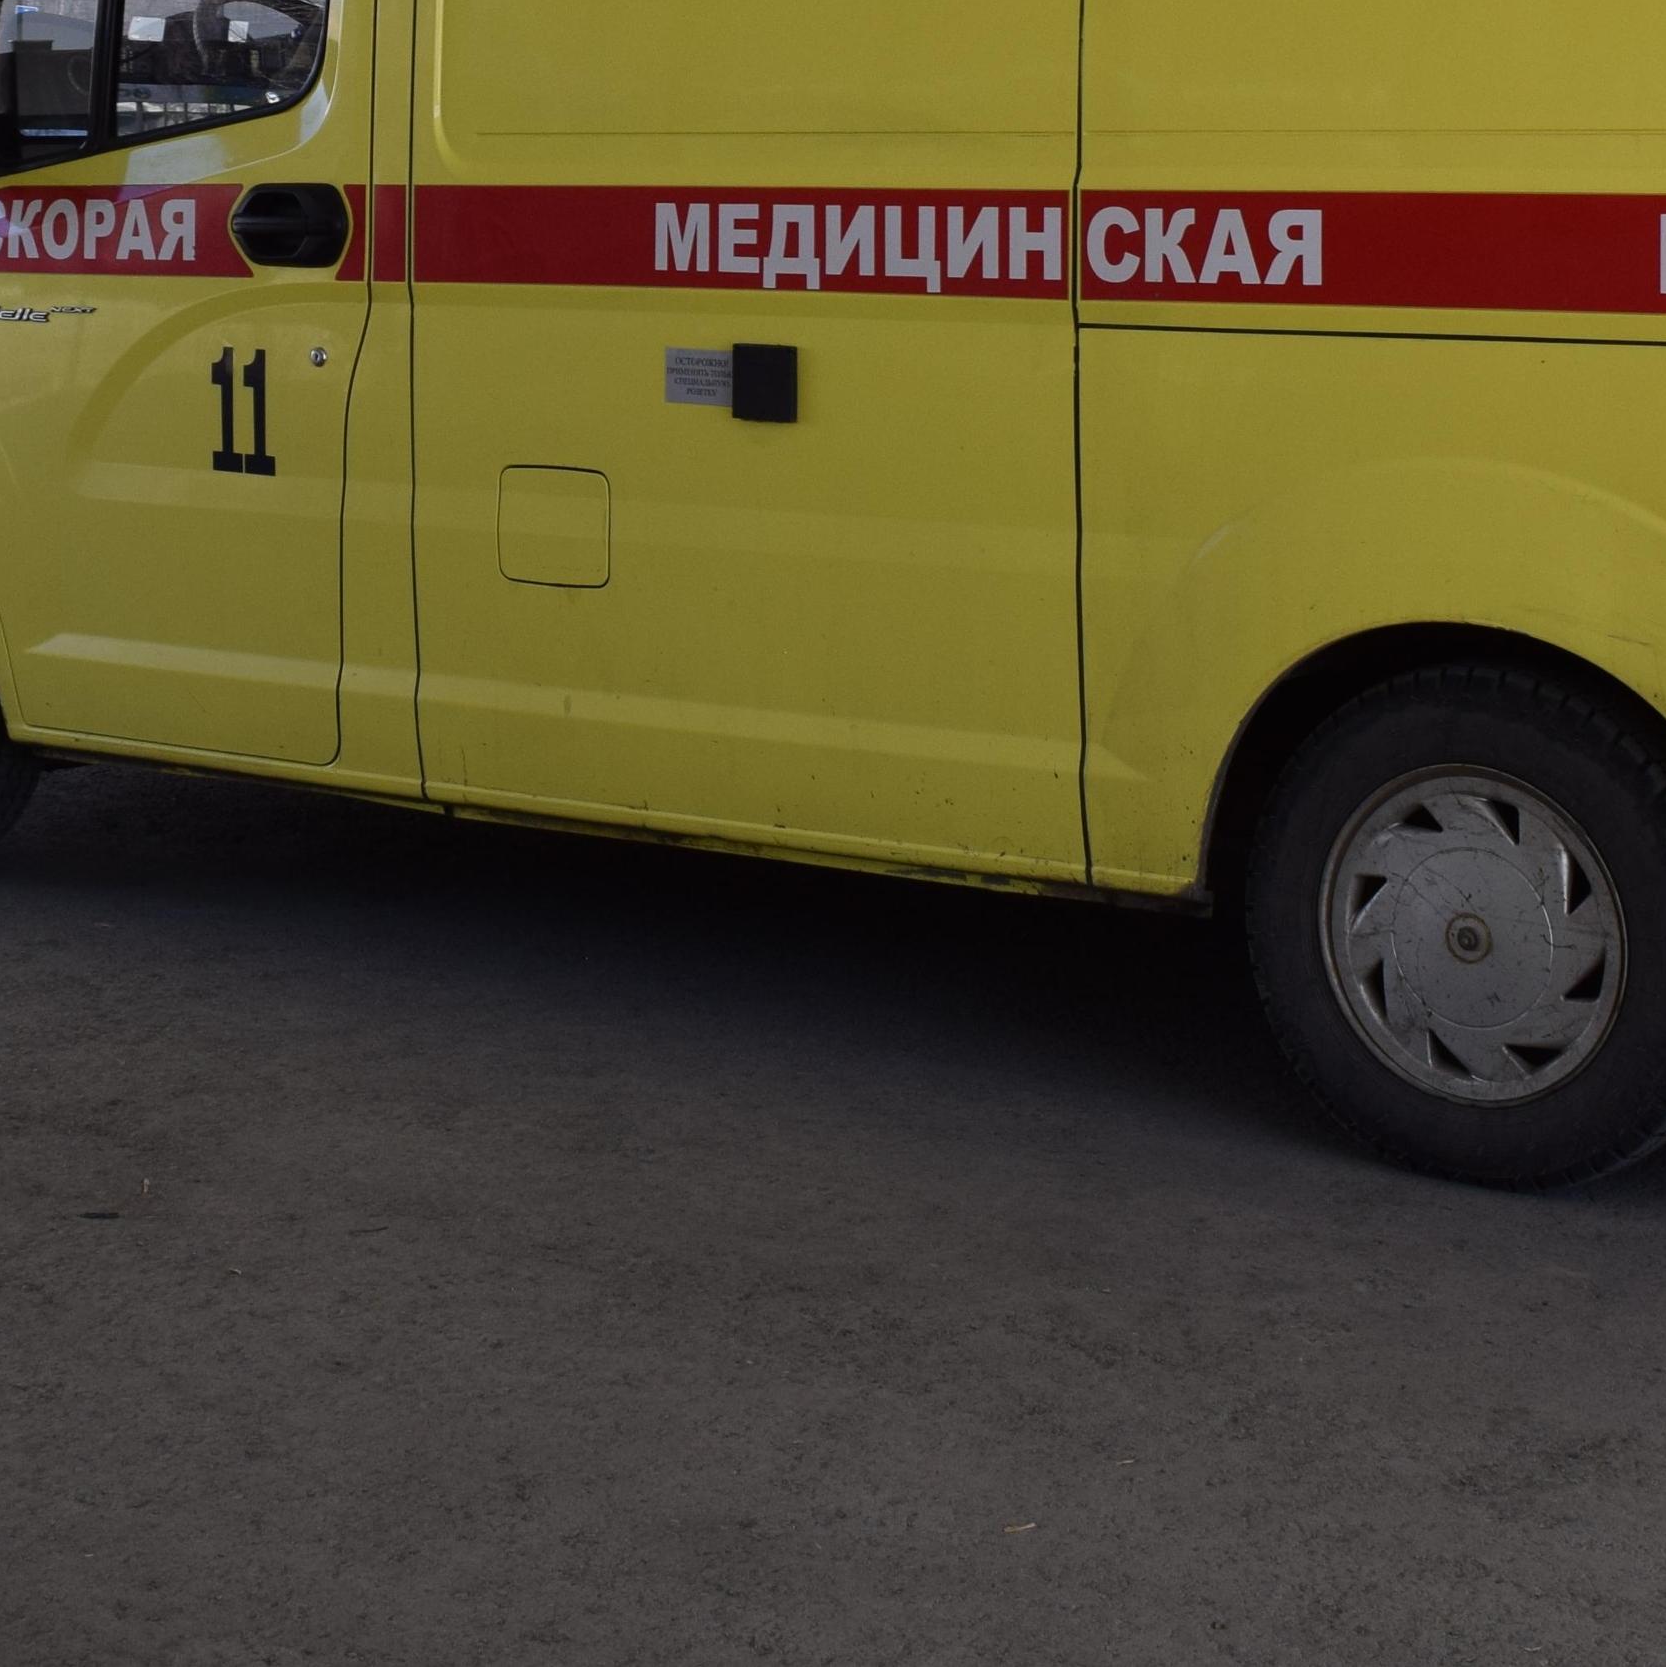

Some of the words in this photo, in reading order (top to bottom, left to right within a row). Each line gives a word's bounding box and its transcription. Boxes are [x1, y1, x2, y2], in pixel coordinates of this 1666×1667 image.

[654, 203, 1324, 293] МЕДИЦИНСКАЯ
[50, 305, 97, 314] NEXT
[211, 346, 276, 476] 11
